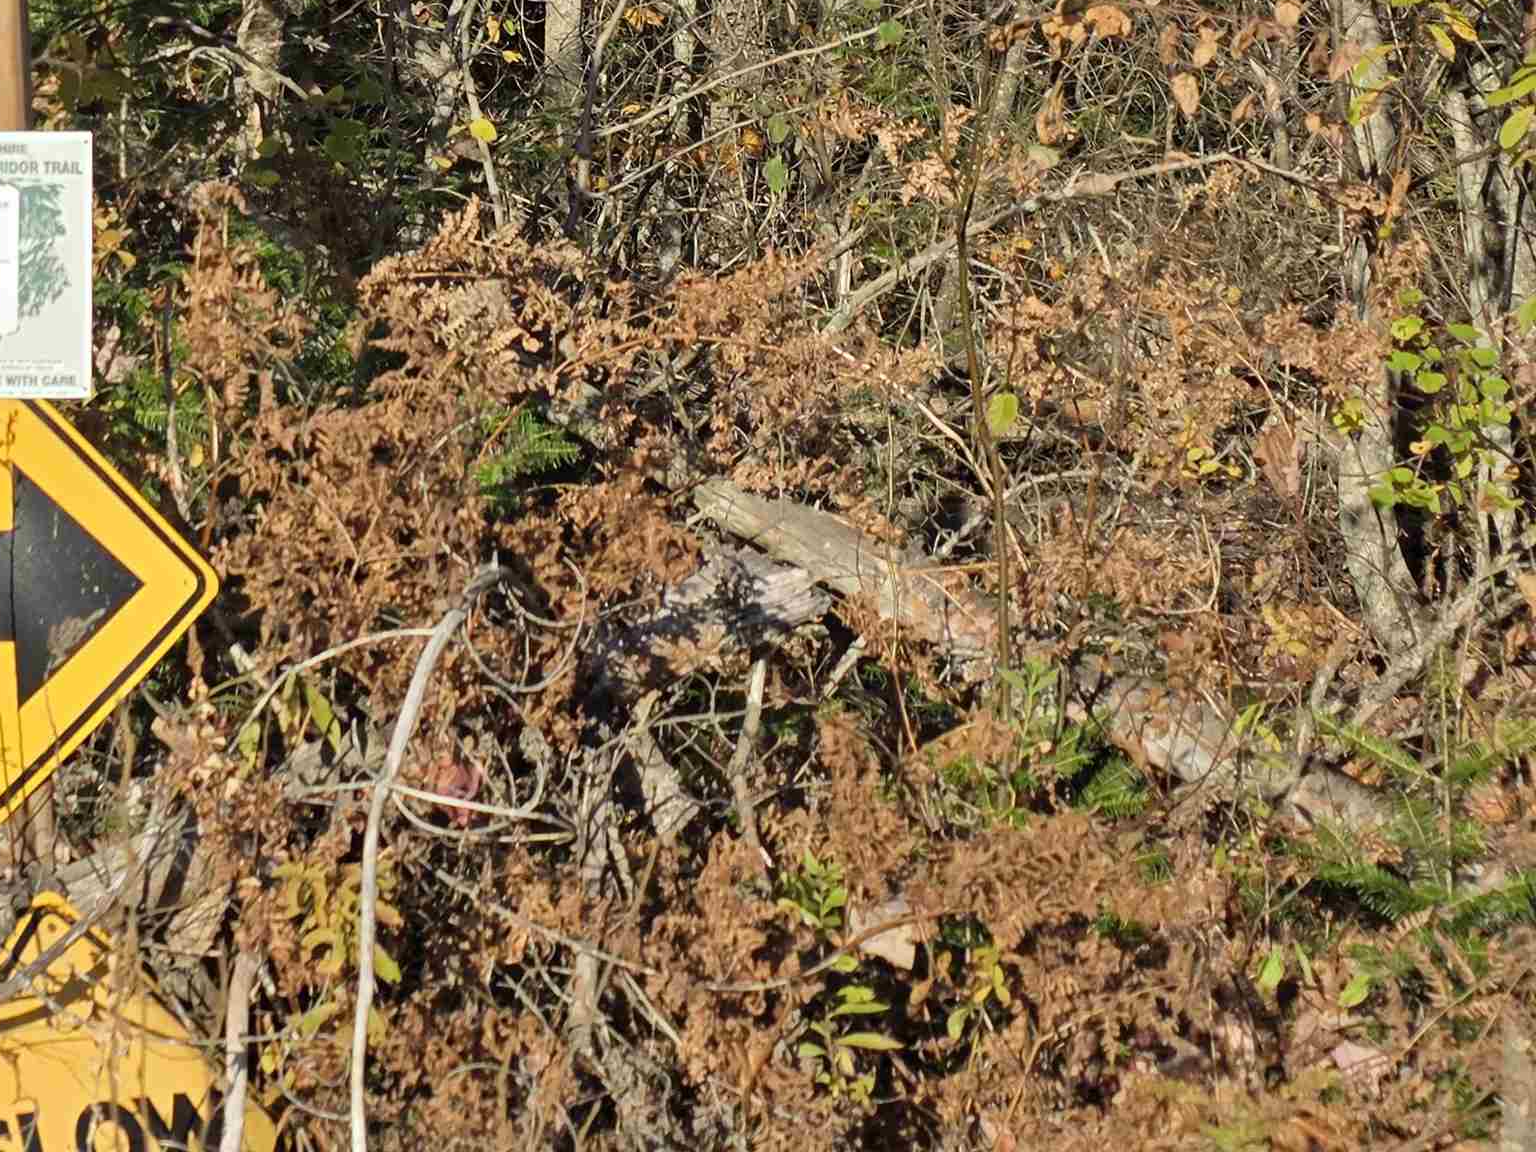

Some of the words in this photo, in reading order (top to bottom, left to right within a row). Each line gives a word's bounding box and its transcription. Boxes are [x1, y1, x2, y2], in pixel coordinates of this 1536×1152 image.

[44, 160, 83, 174] TRAIL
[6, 375, 37, 385] WITH
[40, 375, 77, 385] CARE
